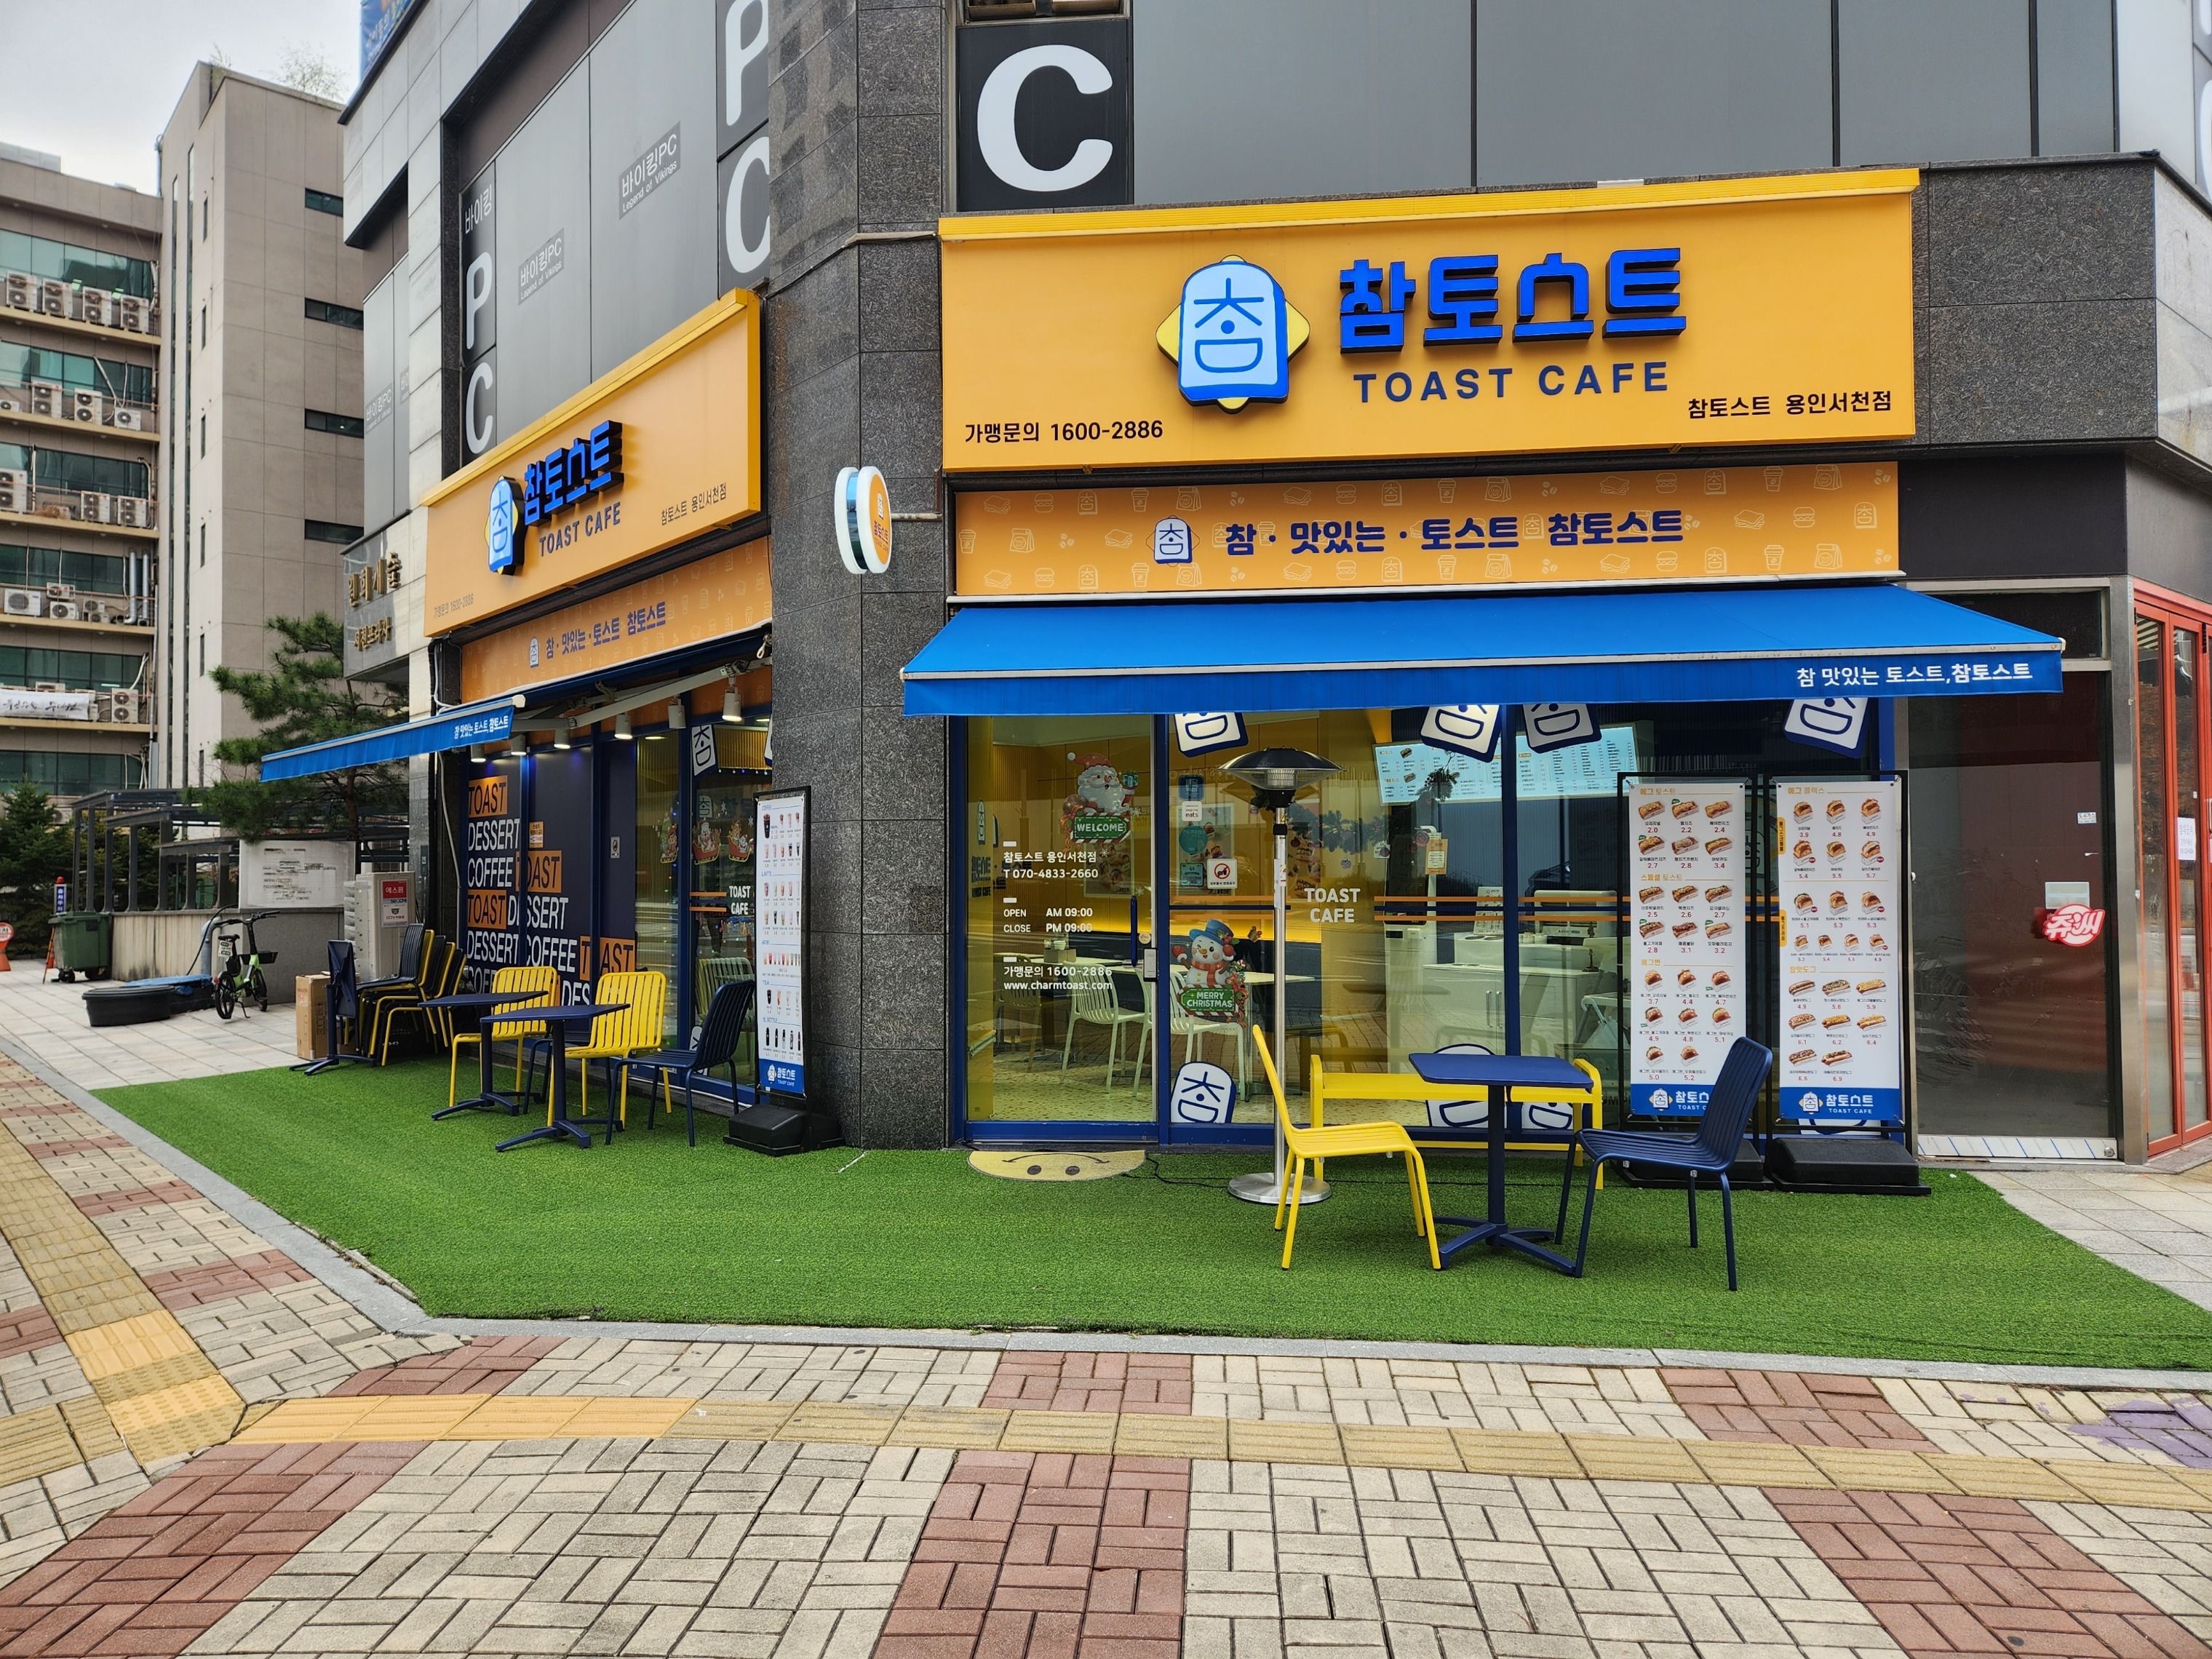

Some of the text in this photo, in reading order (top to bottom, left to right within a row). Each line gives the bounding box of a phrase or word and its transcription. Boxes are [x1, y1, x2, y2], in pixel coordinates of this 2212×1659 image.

[622, 133, 677, 197] 바이킹PC
[623, 160, 677, 212] Legend of Vikings
[464, 183, 493, 235] 바이킹
[520, 238, 562, 286] 바이킹PC
[1340, 247, 1687, 354] 참토스트
[1353, 362, 1668, 403] TOAST CAFE
[1688, 391, 1892, 419] 참토스트 용인서천점
[965, 420, 1163, 443] 가맹문의 1600-2886
[524, 420, 624, 526] 참토스트
[661, 482, 725, 525] 참토스트 용인서천점
[539, 502, 620, 557] TOAST CAFE
[1225, 510, 1684, 556] 참 맛있는 토스트 참토스트
[546, 601, 666, 659] 참 맛있는 토스트 참토스트
[1797, 668, 1815, 688] 참
[1821, 666, 1879, 686] 맛있는
[454, 725, 460, 739] 참
[460, 723, 474, 739] 맛있는
[469, 781, 507, 816] TOAST
[1656, 787, 1676, 795] 토스트
[468, 819, 520, 851] DESSERT
[1077, 822, 1125, 832] WELCOME
[1003, 851, 1097, 863] 참토스트 용인서천점
[468, 857, 514, 887] COFFEE
[1003, 869, 1099, 878] T 070-4833-2660
[729, 886, 751, 898] TOAST
[1304, 888, 1361, 903] TOAST
[468, 894, 506, 925] TOAST
[731, 902, 749, 915] CAFE
[1003, 908, 1093, 918] OPEN AM 09:00
[1310, 908, 1355, 923] CAFE
[1003, 923, 1093, 933] CLOSE PM 09:00
[467, 931, 520, 964] DESSERT
[581, 939, 634, 974] TAST
[1003, 966, 1113, 977] 가맹문의 1600-2886
[1003, 981, 1113, 990] www.charmtoast.com
[1196, 991, 1225, 1000] MERRY
[1186, 1000, 1233, 1008] CHRISTMAS
[777, 1067, 796, 1081] 참토스트
[1676, 1091, 1709, 1104] 참토스
[1826, 1094, 1874, 1107] 참토스트
